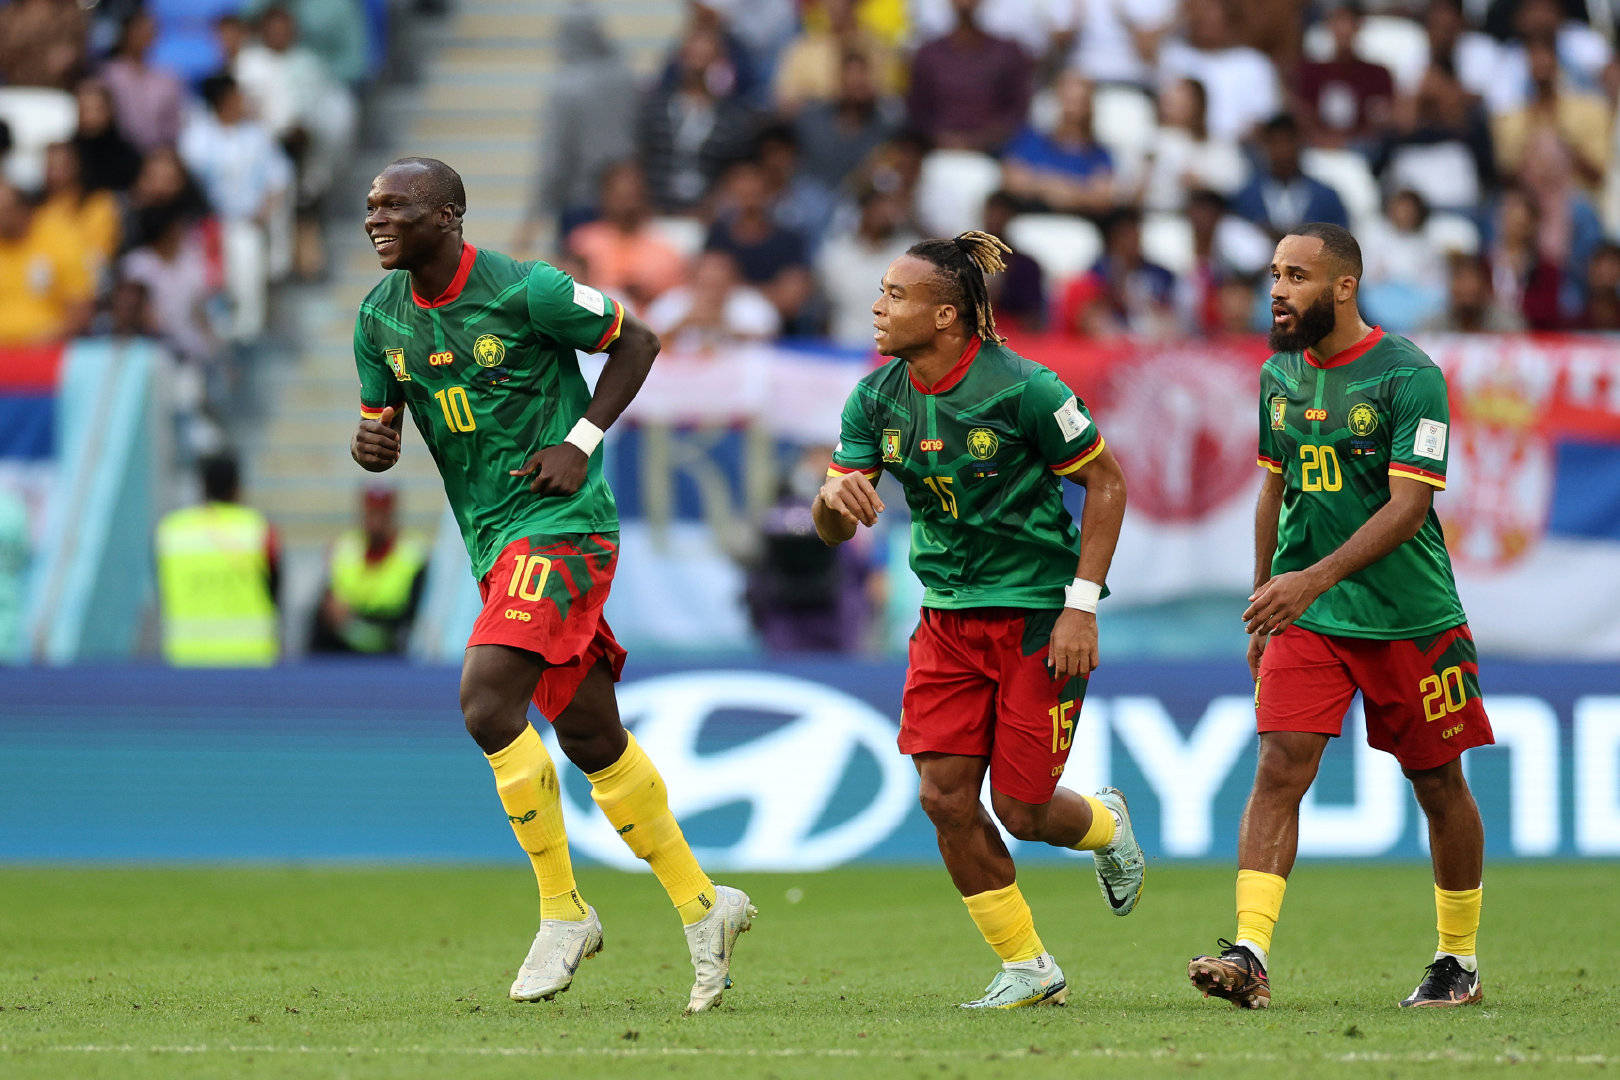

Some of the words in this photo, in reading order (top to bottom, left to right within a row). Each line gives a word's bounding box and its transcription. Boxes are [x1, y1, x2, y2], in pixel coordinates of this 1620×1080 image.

[430, 352, 453, 366] one
[434, 386, 476, 433] 10
[1305, 408, 1328, 421] one
[920, 439, 943, 452] one
[1300, 444, 1343, 492] 20
[923, 476, 958, 519] 15
[507, 554, 552, 602] 10
[504, 608, 532, 622] one
[1419, 665, 1467, 722] 20
[1048, 700, 1074, 754] 15
[1441, 722, 1464, 739] one
